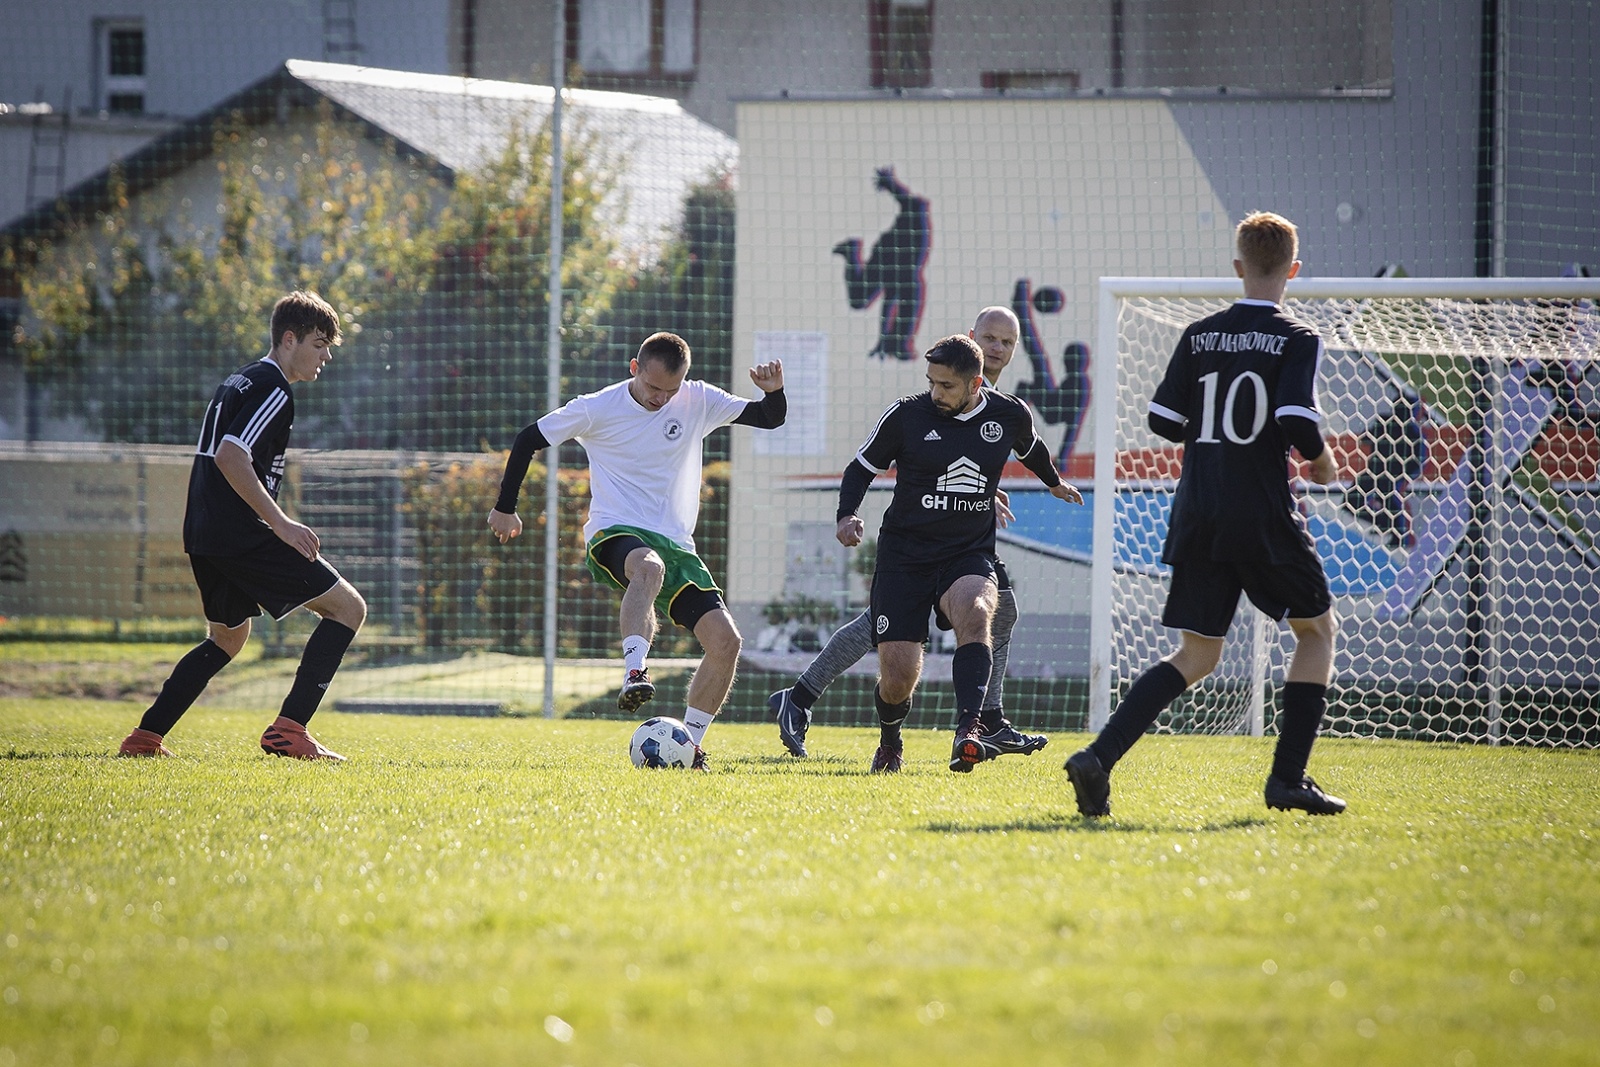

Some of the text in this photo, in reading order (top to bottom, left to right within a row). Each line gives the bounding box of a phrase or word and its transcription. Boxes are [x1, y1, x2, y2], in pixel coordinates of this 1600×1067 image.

[1195, 370, 1268, 445] 10
[921, 494, 991, 512] GH Invest
